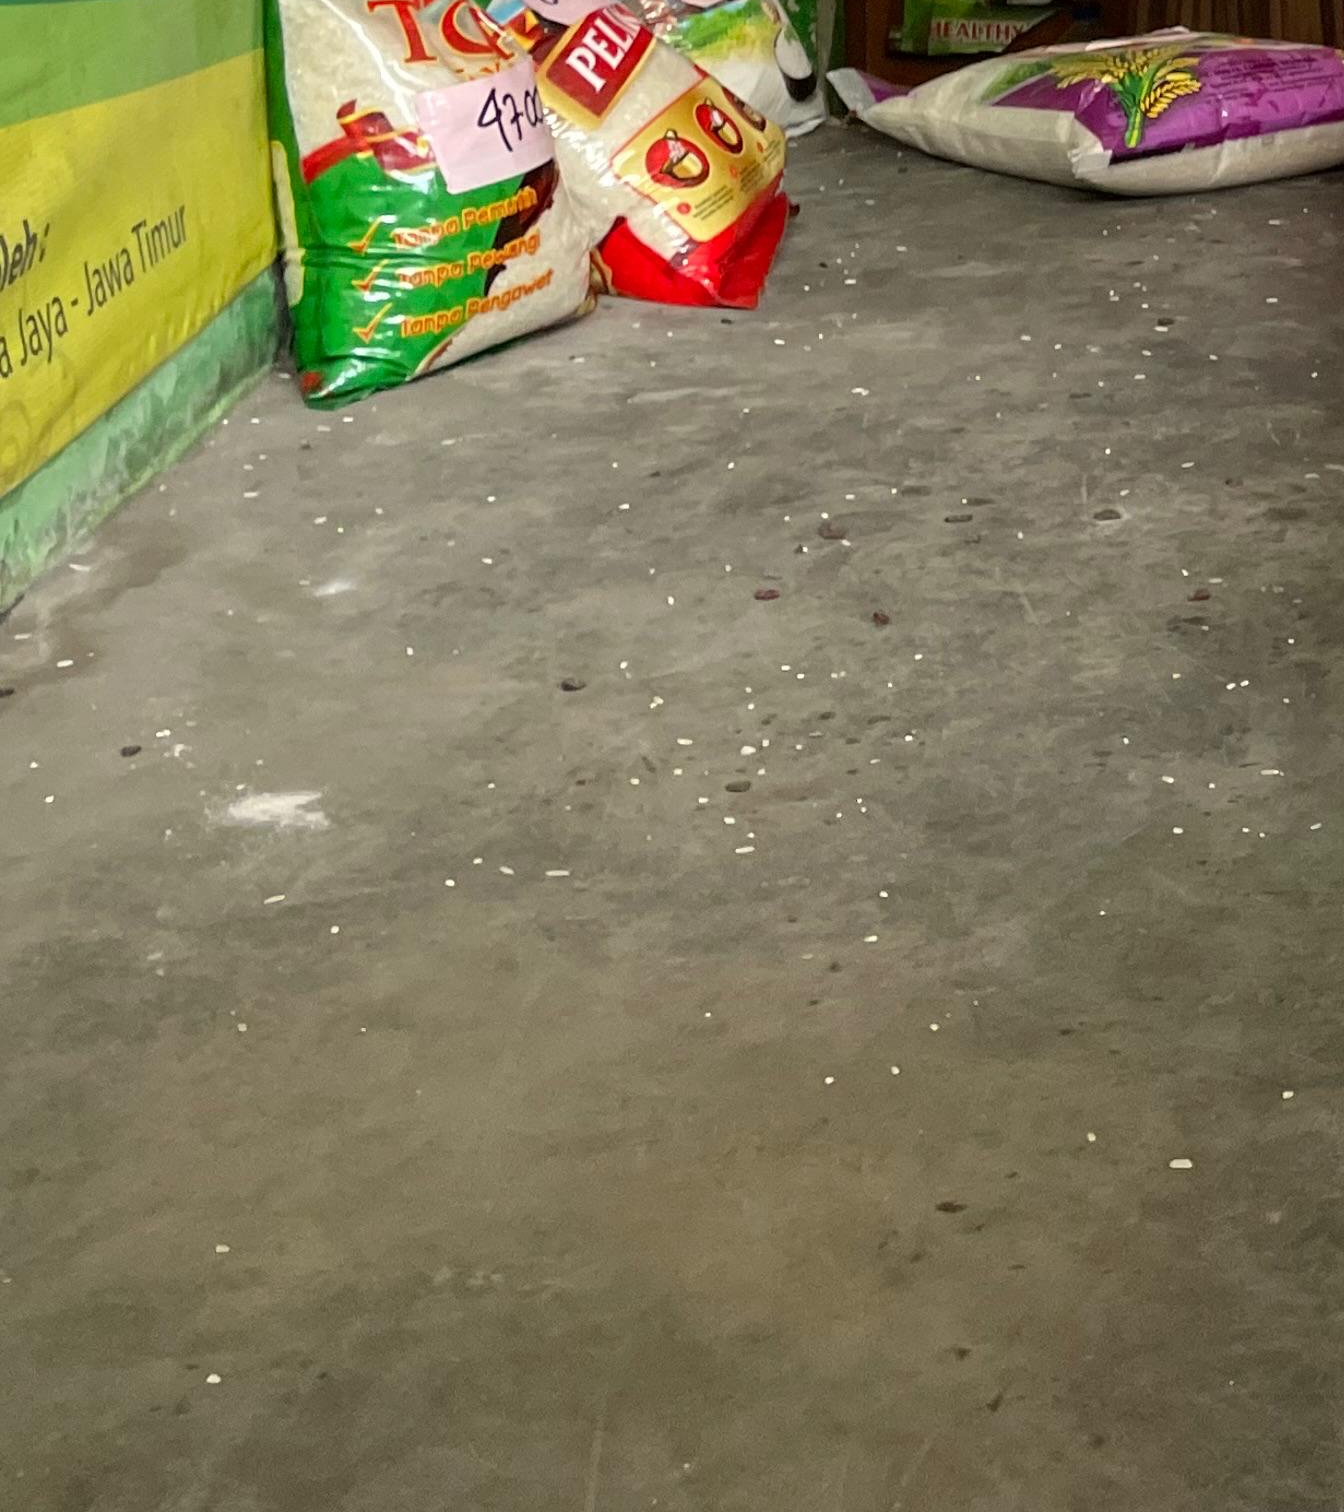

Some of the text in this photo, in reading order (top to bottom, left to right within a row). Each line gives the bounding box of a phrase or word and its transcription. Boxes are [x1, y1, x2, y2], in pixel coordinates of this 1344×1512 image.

[0, 218, 50, 292] leh:
[17, 295, 69, 367] Jaya
[83, 246, 135, 318] Jawa
[131, 203, 188, 274] Timur
[465, 267, 555, 319] Pengawet
